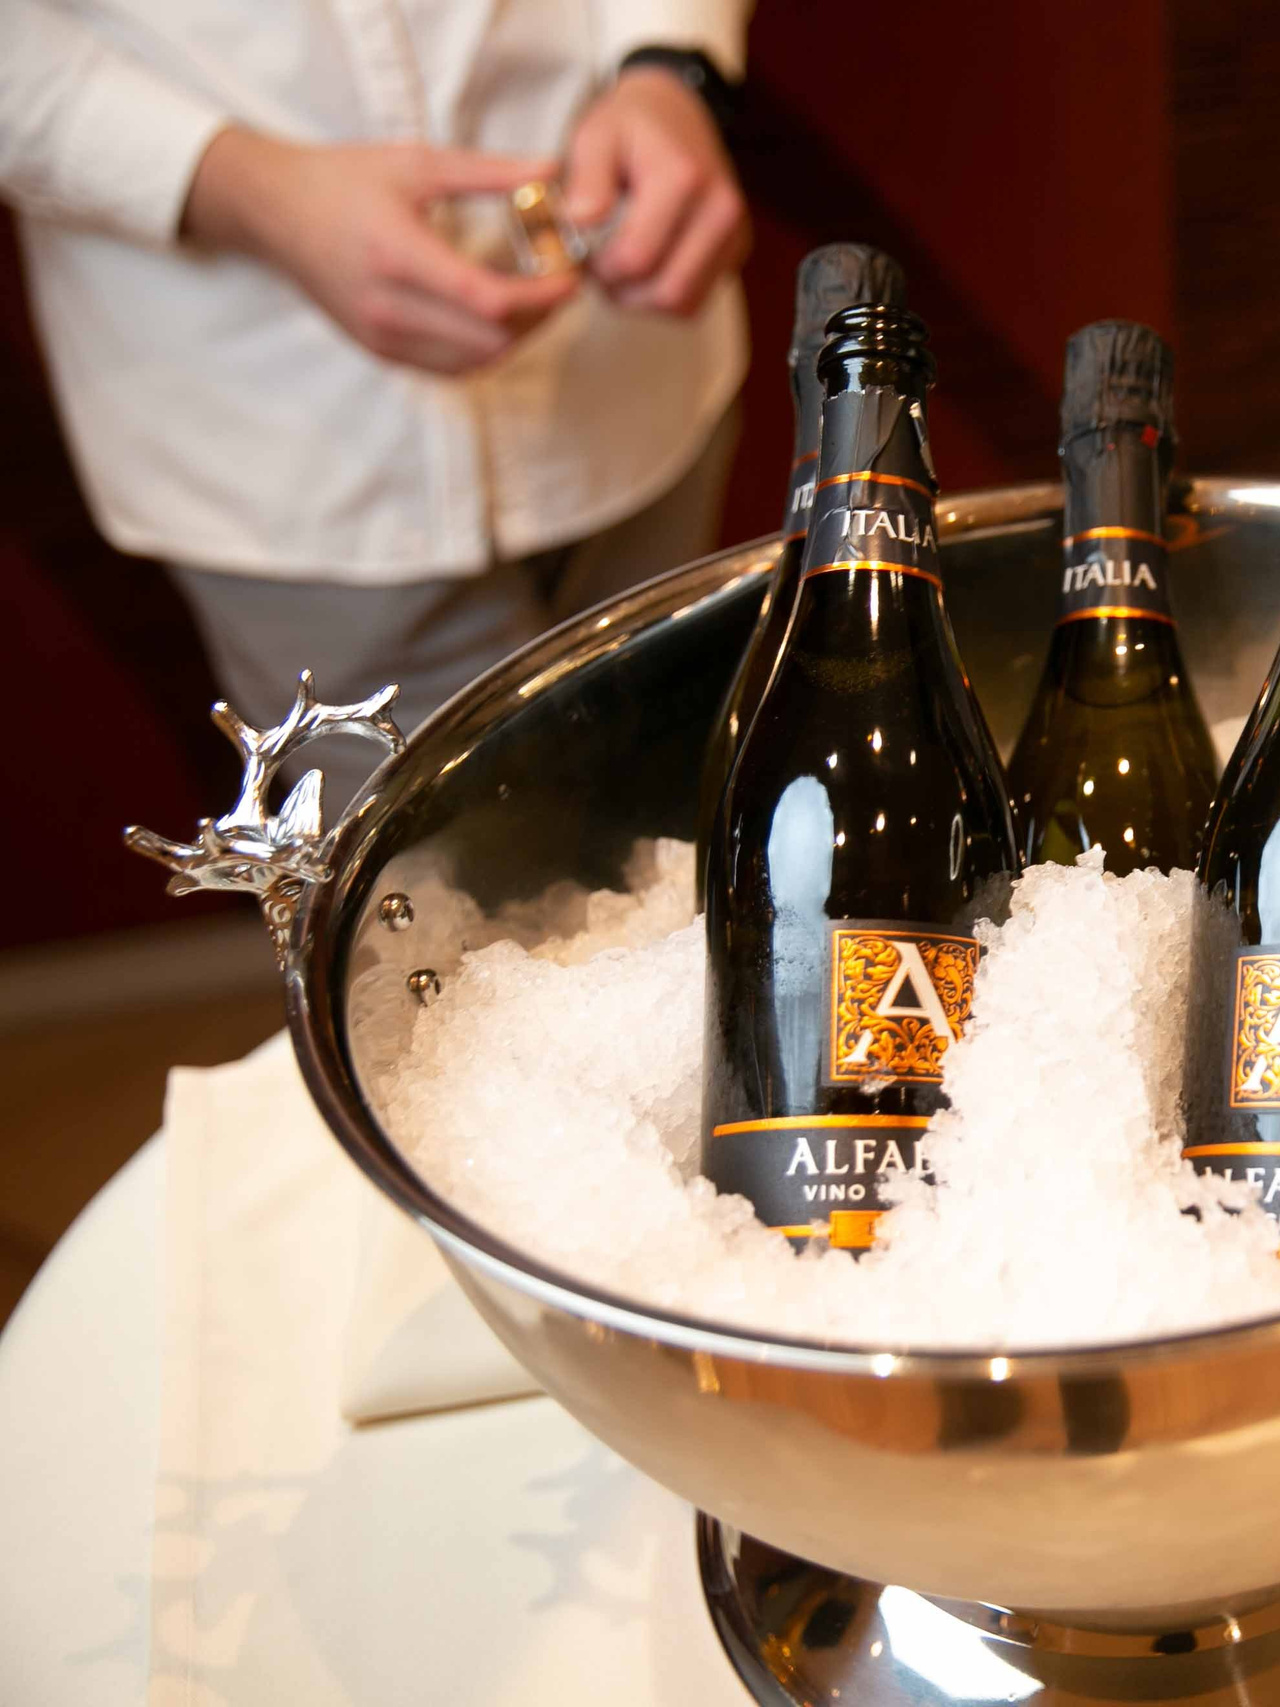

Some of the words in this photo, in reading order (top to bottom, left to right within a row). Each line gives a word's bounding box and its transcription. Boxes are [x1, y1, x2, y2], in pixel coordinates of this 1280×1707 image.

[840, 509, 938, 554] ITALIA
[1062, 558, 1158, 594] ITALIA
[840, 940, 958, 1064] A
[803, 1182, 866, 1202] VINO
